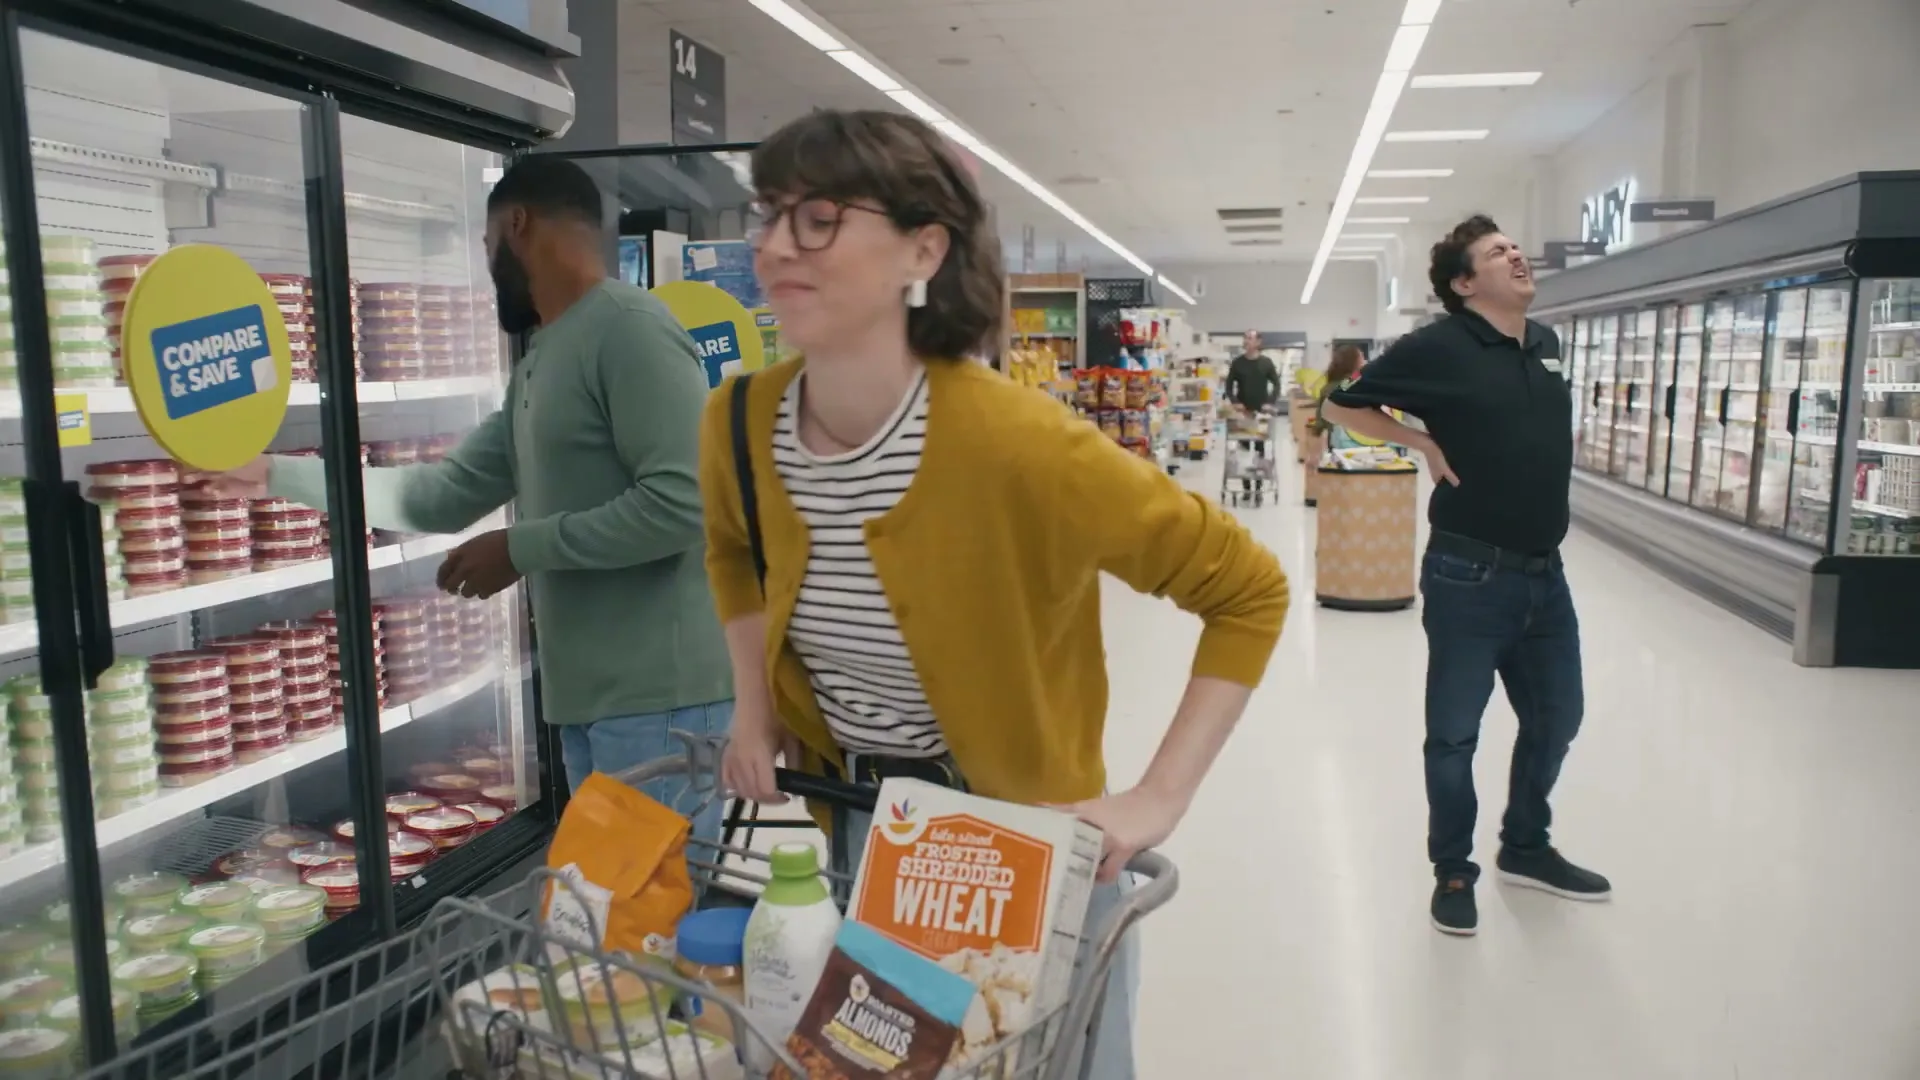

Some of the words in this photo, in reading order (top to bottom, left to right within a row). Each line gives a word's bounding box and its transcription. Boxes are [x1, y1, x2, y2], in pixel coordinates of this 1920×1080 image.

[675, 39, 696, 79] 14
[163, 324, 262, 371] COMPARE
[170, 373, 189, 398] &
[188, 356, 242, 392] SAVE
[898, 855, 1015, 889] SHREDDED
[914, 841, 1003, 865] FROSTED
[893, 876, 1013, 938] WHEAT
[834, 996, 913, 1057] ALMONDS
